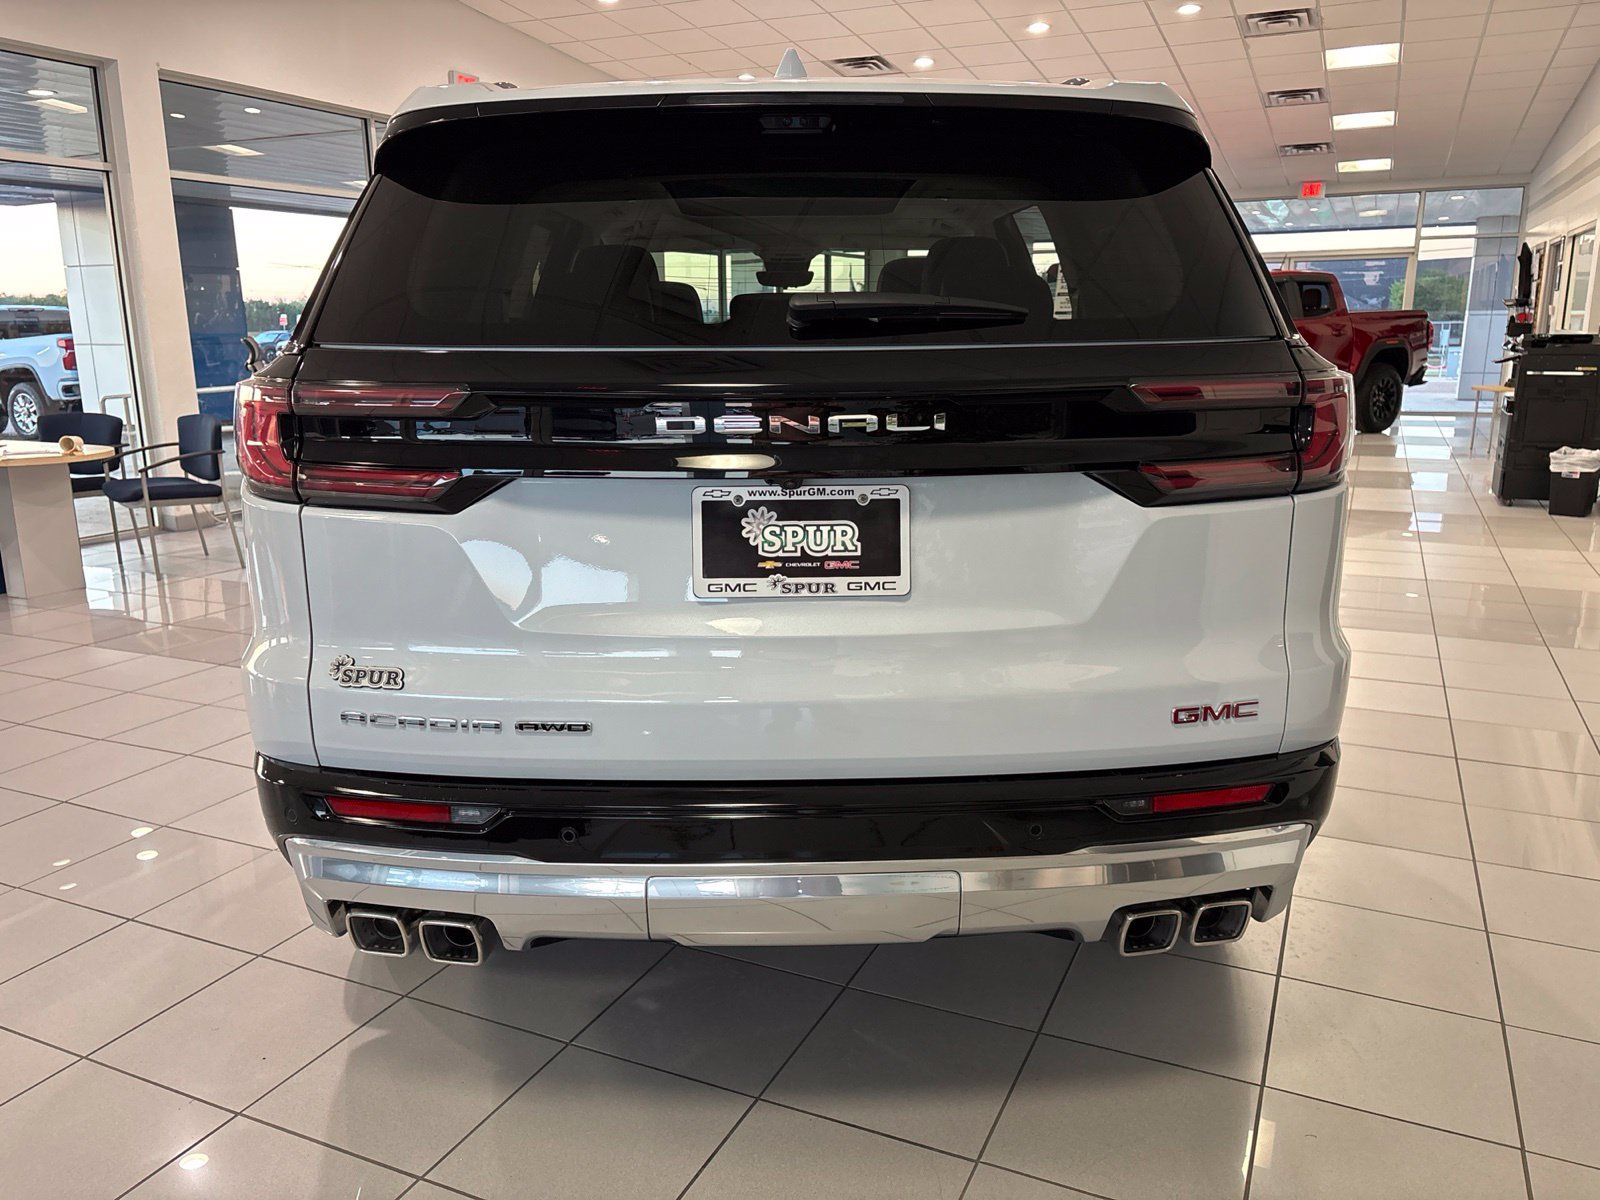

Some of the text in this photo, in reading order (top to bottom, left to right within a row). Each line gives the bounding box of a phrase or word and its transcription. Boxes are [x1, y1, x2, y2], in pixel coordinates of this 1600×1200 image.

[655, 412, 947, 435] DENALI
[747, 487, 855, 498] www.SpurGM.com
[762, 523, 859, 554] SPUR
[823, 560, 860, 570] GMC
[707, 583, 758, 593] GMC
[780, 581, 837, 595] SPUR
[846, 581, 897, 591] GMC
[340, 667, 402, 687] SPUR
[340, 711, 592, 733] ACADIA AWD
[1171, 700, 1259, 727] GMC
